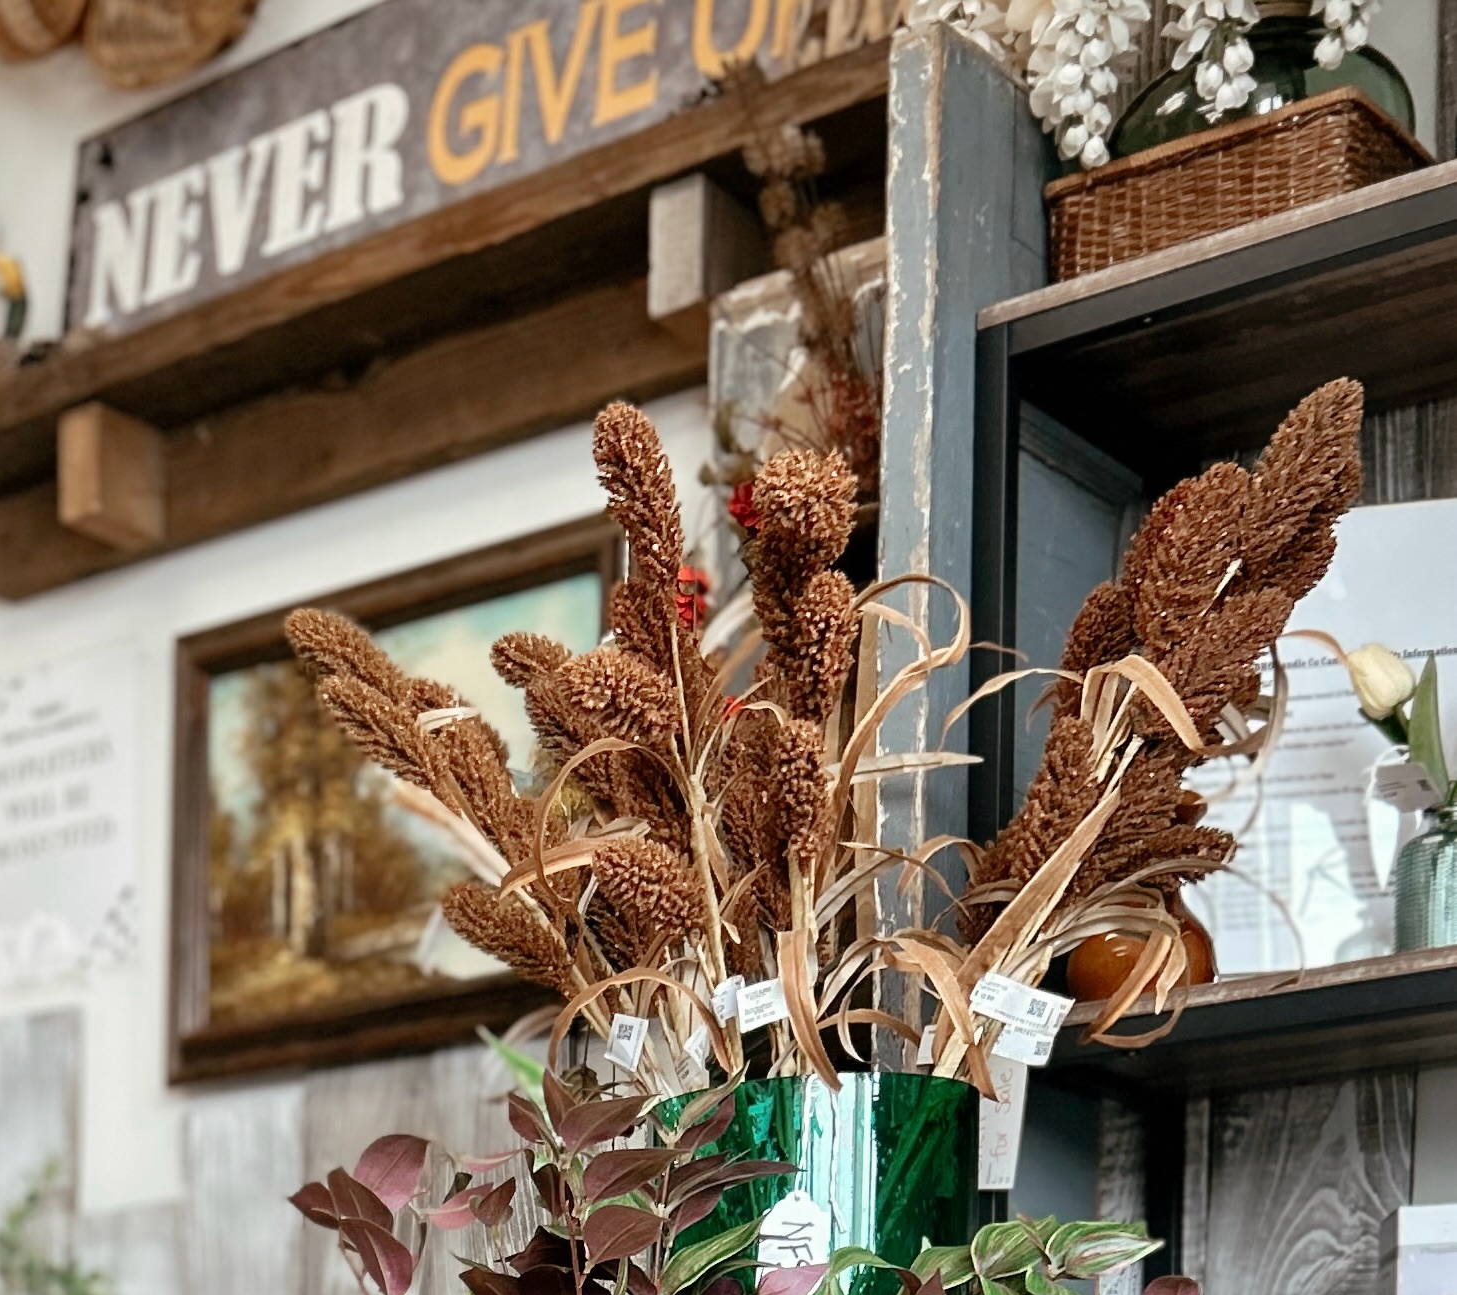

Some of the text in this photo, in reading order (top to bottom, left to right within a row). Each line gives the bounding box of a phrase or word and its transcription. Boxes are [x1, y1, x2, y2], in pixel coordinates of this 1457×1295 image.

[83, 81, 410, 326] NEVER
[428, 0, 661, 186] GIVE
[995, 1068, 1014, 1114] Sale
[777, 1221, 815, 1267] NF
